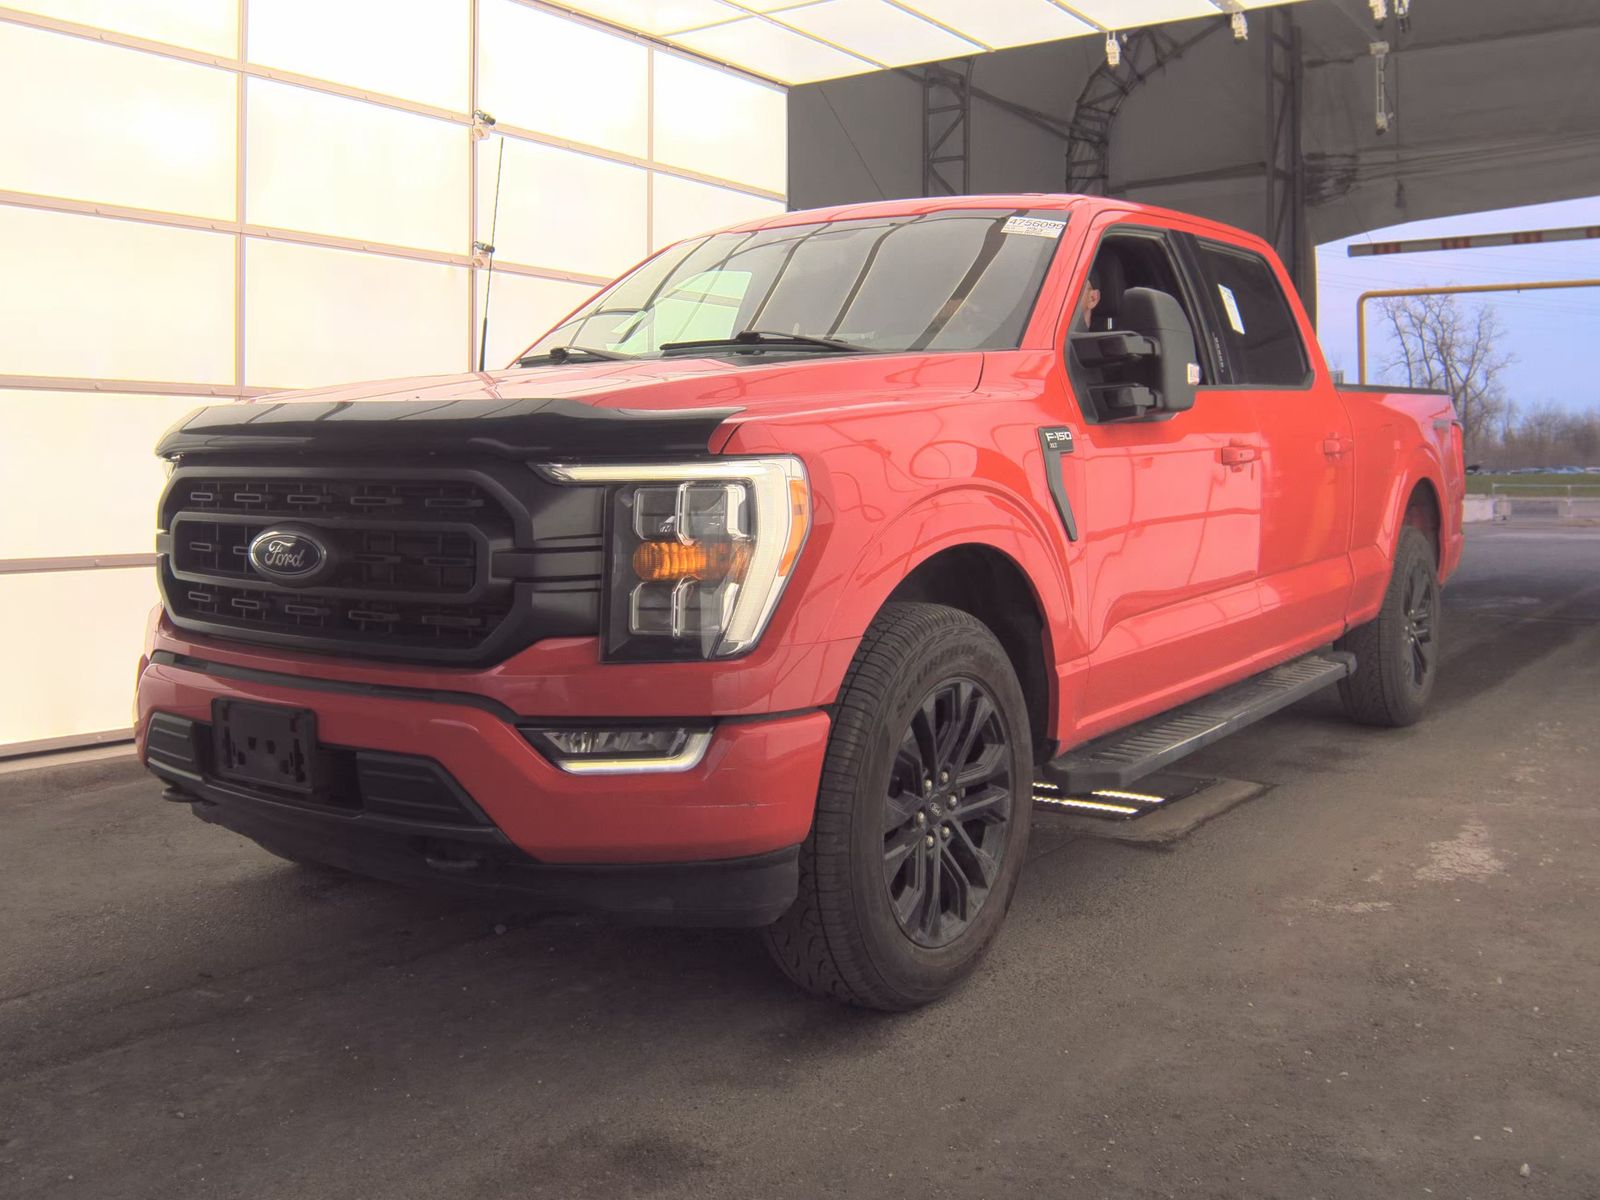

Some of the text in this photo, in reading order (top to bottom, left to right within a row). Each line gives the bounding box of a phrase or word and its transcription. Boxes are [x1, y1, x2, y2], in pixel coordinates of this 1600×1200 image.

[1009, 218, 1064, 230] 4756099
[1045, 431, 1072, 441] F-150
[264, 540, 305, 567] Ford
